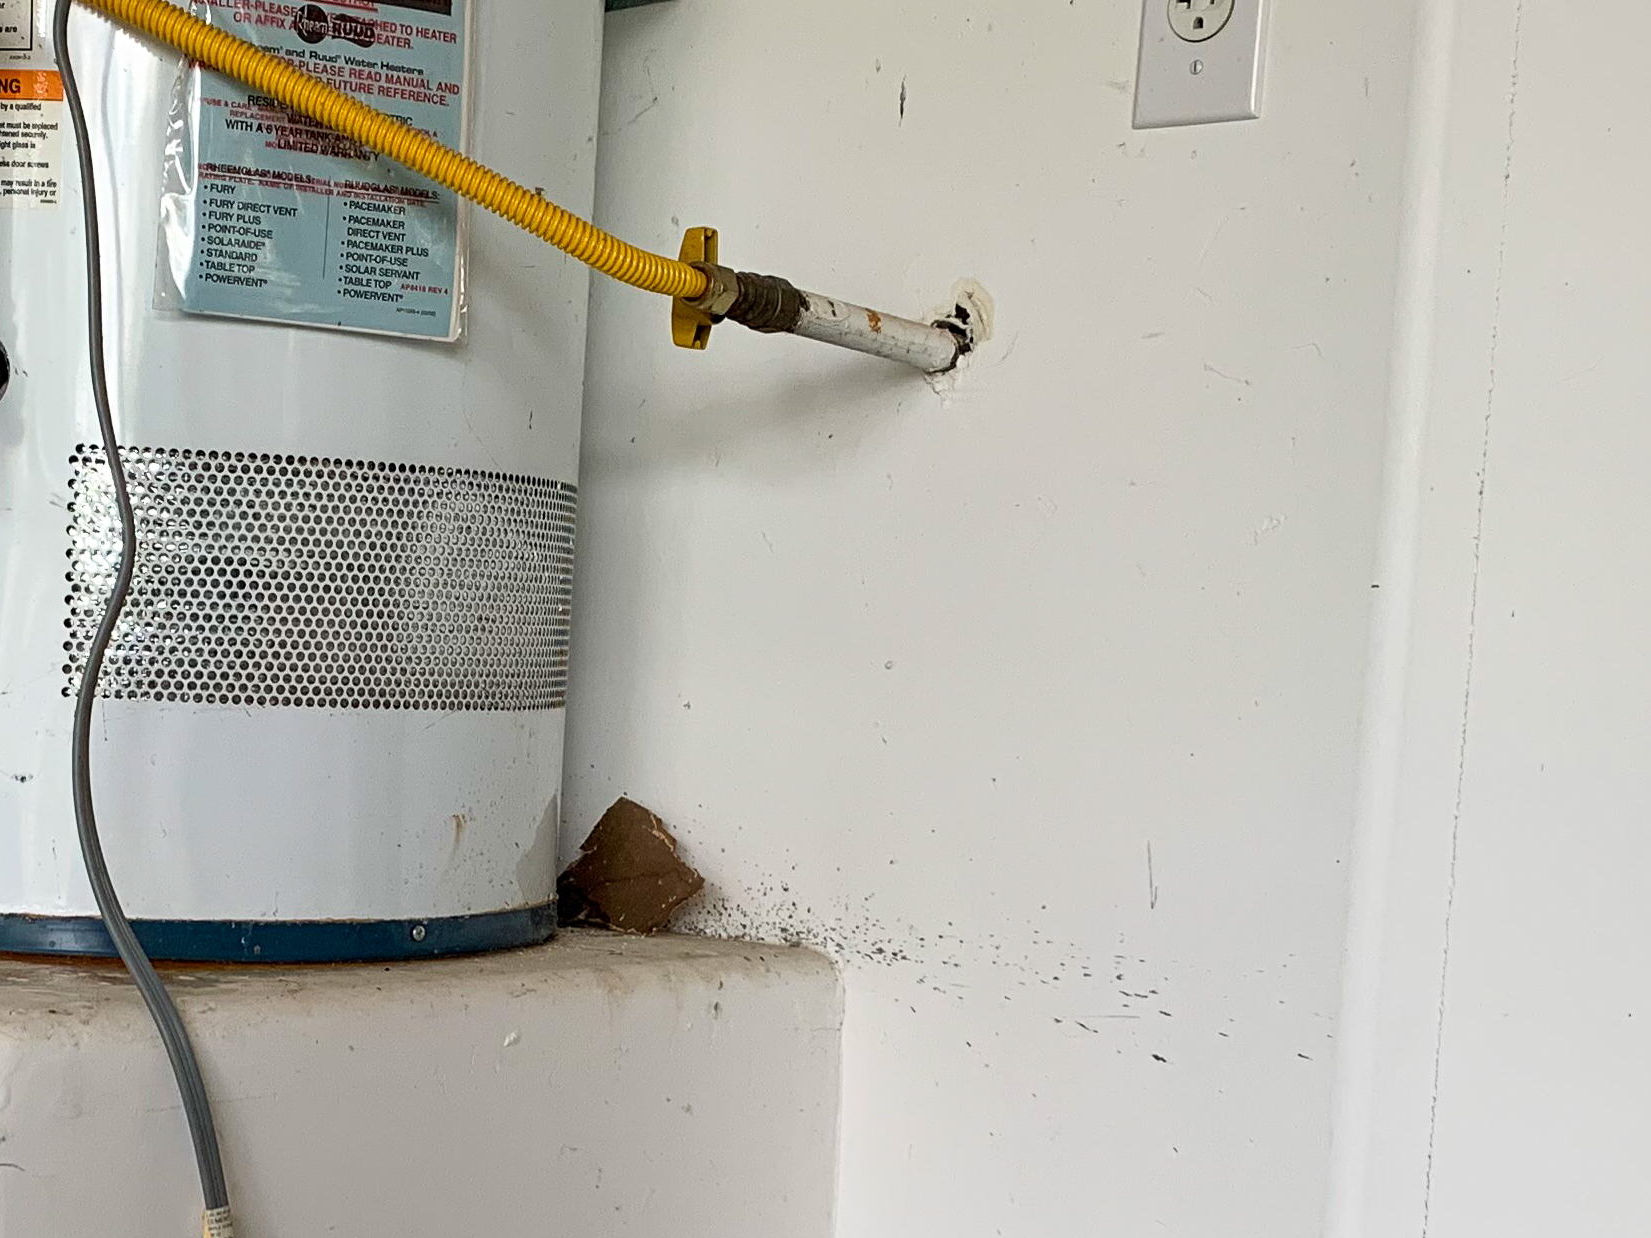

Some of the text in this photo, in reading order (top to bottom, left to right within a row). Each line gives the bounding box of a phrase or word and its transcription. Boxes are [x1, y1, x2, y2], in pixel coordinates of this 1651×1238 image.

[234, 12, 252, 24] OR
[255, 14, 286, 29] AFFIX
[376, 33, 413, 49] EATER.
[399, 24, 413, 37] TO
[416, 27, 457, 44] HEATER
[285, 49, 306, 59] and
[344, 56, 378, 70] Water
[380, 61, 425, 77] Heaters
[349, 68, 460, 96] READ MANUAL AND
[378, 88, 450, 108] REFERENCE.
[1, 102, 8, 111] by
[15, 103, 42, 111] qualified
[225, 119, 253, 133] WITH
[274, 125, 303, 141] YEAR
[12, 141, 29, 150] glass
[1, 179, 13, 188] may
[47, 178, 58, 188] fire
[210, 183, 236, 195] FURY
[3, 188, 30, 196] personal
[31, 189, 48, 197] injury
[209, 198, 298, 218] FURY DIRECT VENT
[349, 200, 406, 216] PACEMAKER
[208, 210, 262, 226] FURY PLUS
[348, 214, 405, 230] PACEMAKER
[207, 222, 273, 240] POINT-OF-USE
[347, 227, 406, 243] DIRECT VENT
[206, 247, 258, 263] STANDARD
[347, 239, 429, 258] PACEMAKER PLUS
[346, 251, 409, 267] POINT-OF-USE
[205, 260, 256, 275] TABLE TOP
[345, 263, 421, 281] SOLAR SERVANT
[343, 276, 392, 290] TABLE TOP
